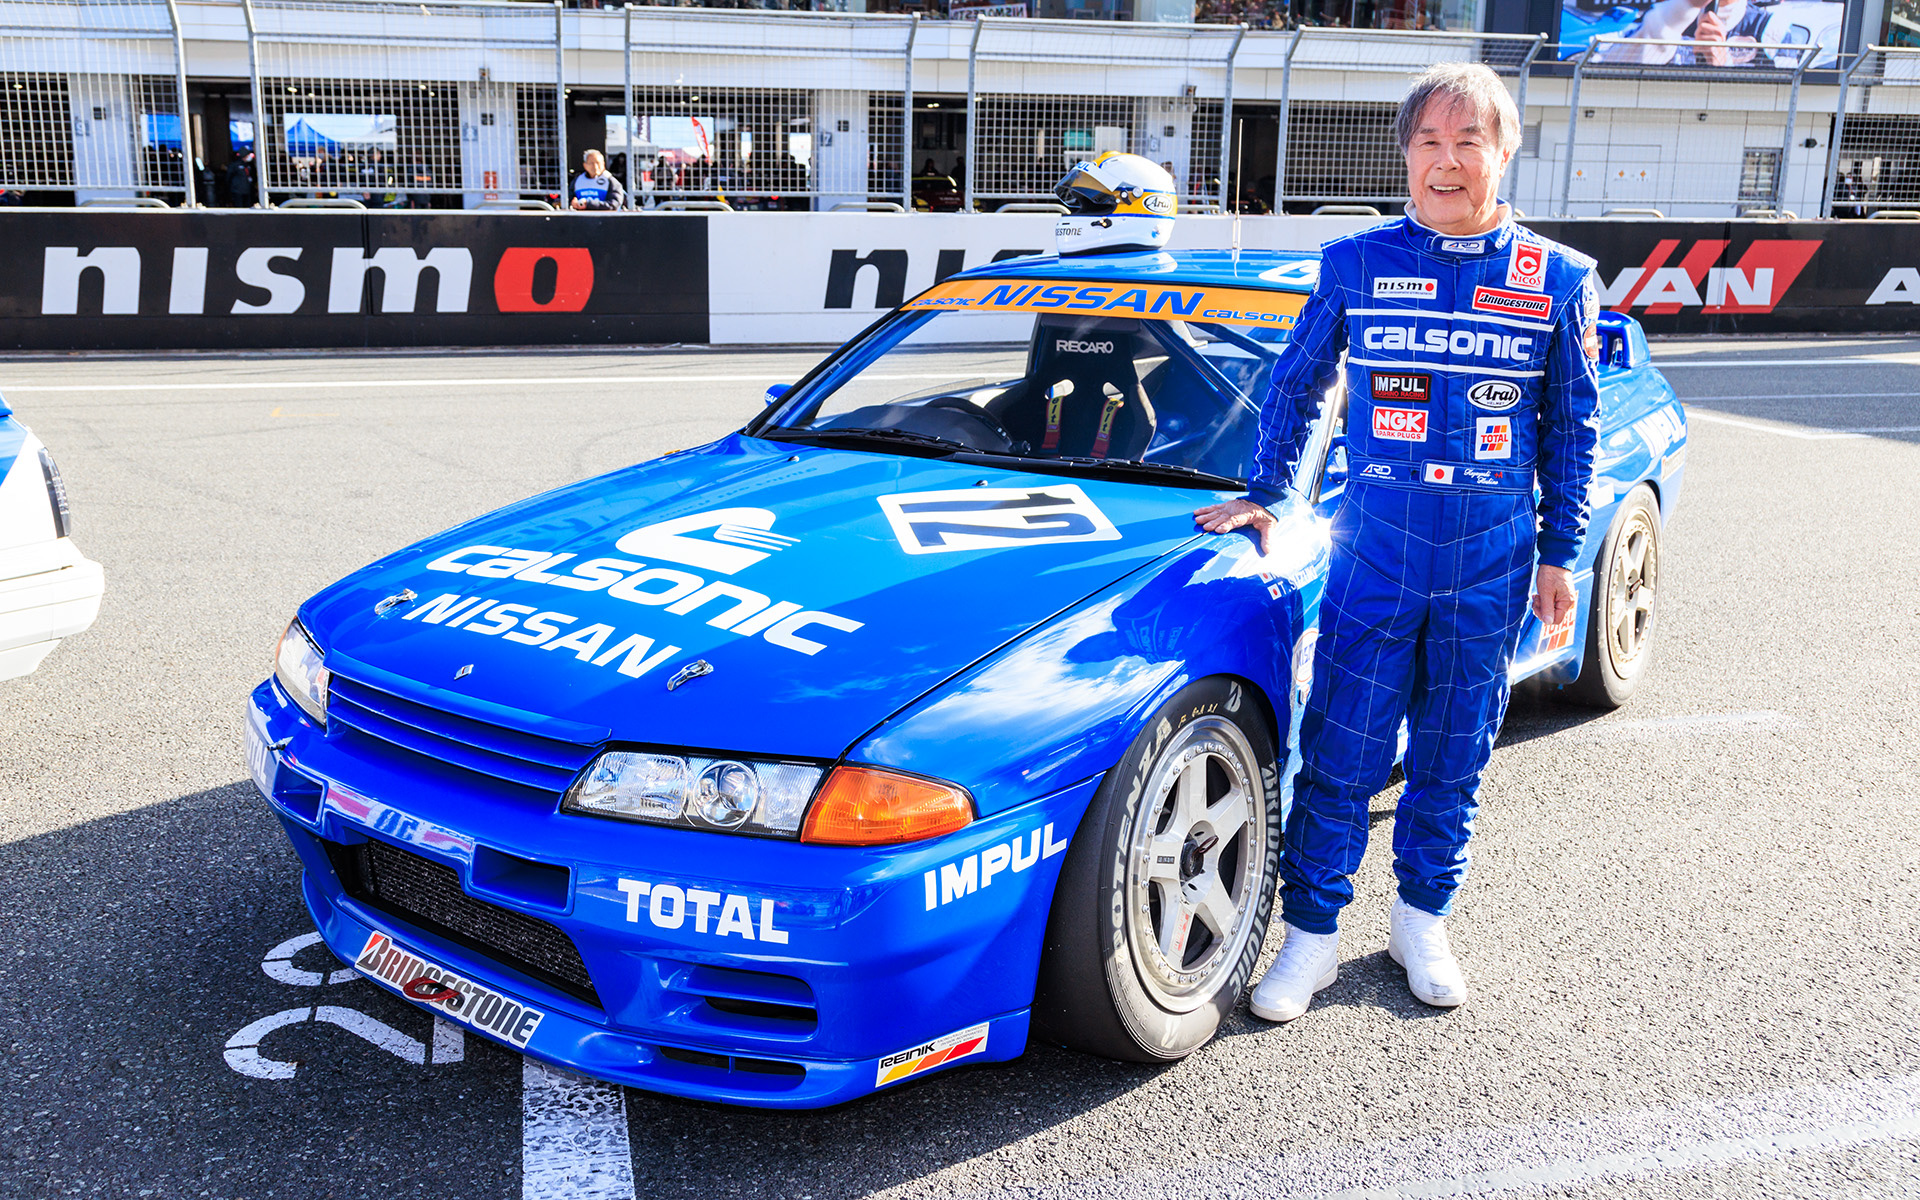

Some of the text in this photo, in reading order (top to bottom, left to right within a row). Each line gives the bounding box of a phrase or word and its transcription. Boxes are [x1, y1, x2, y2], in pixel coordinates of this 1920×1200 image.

[41, 246, 595, 316] nismo
[1510, 272, 1542, 286] NICOS
[977, 284, 1205, 316] NISSAN
[1202, 309, 1299, 326] CALSON
[1478, 293, 1548, 312] BRIDGESTONE
[1056, 339, 1114, 354] RECARO
[1374, 376, 1425, 393] IMPUL
[1474, 385, 1516, 401] Arai
[1375, 411, 1424, 433] NGK
[1375, 430, 1422, 440] SPARK PLUGS
[1481, 433, 1509, 444] TOTAL
[898, 492, 1097, 548] 12
[402, 593, 682, 679] NISSAN
[924, 822, 1068, 911] IMPUL
[1228, 761, 1280, 1003] BRIDGESTONE
[617, 878, 790, 945] TOTAL
[356, 933, 540, 1045] BRIDGESTONE
[880, 1042, 936, 1069] REINIK
